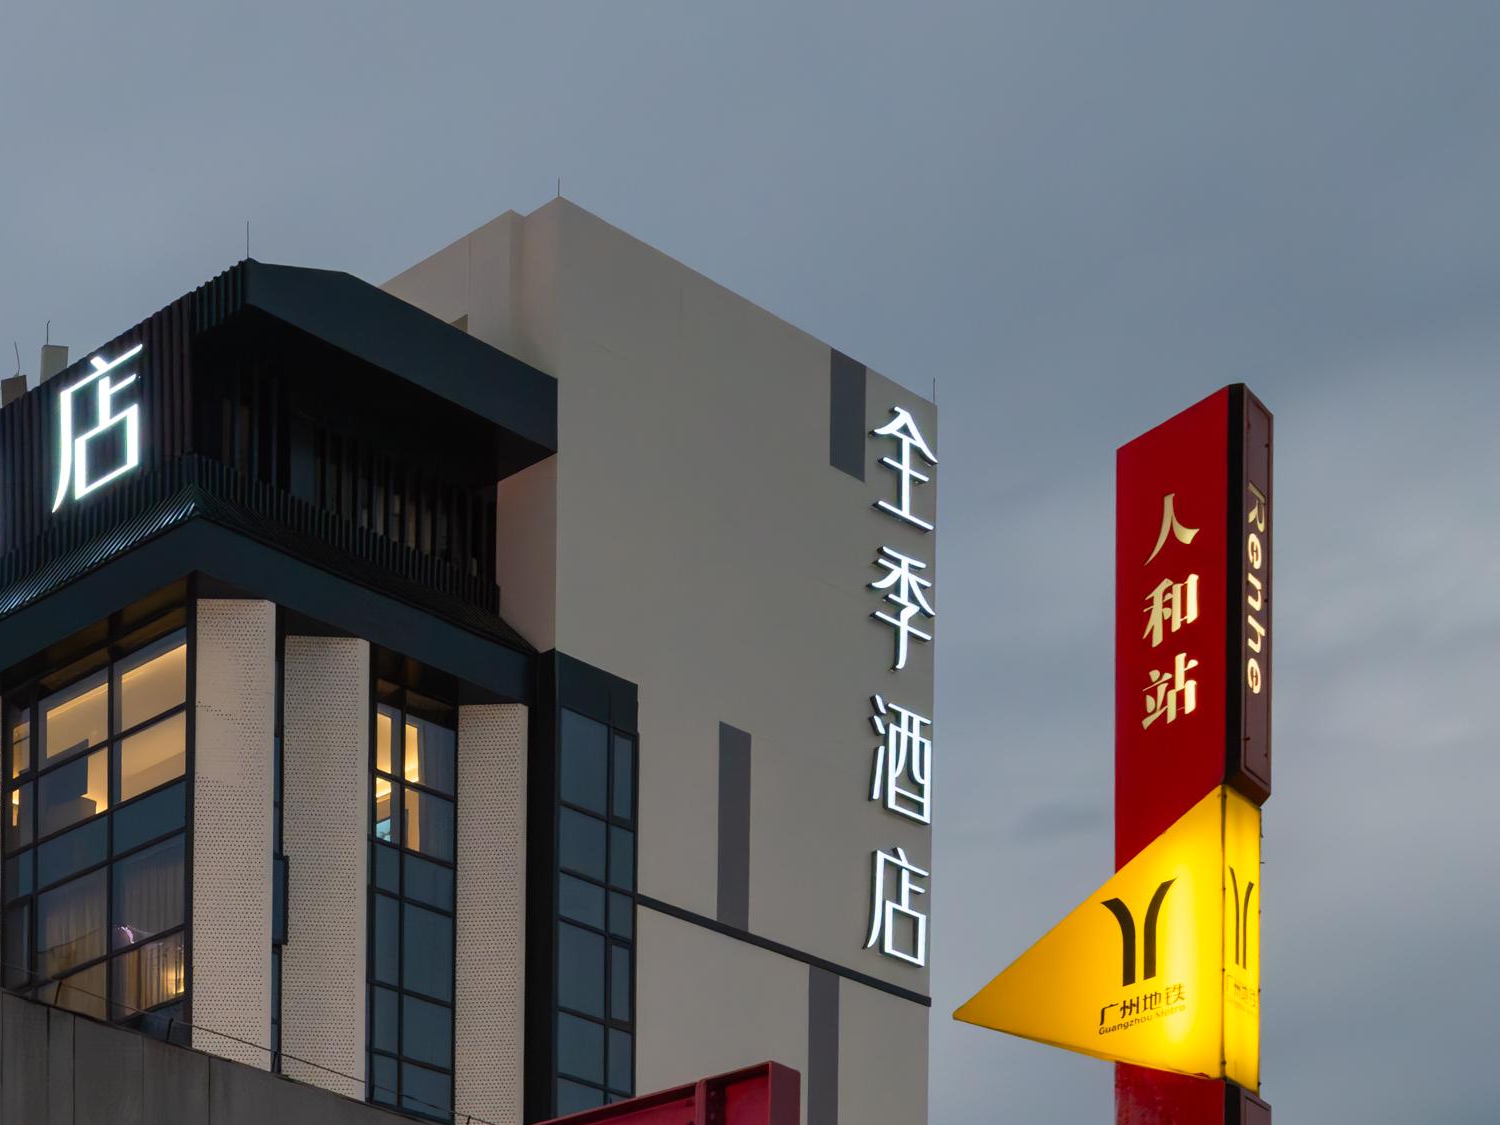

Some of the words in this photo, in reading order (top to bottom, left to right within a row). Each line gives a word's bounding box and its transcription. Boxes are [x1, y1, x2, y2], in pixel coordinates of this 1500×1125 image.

[863, 405, 938, 968] 全季酒店
[1141, 493, 1200, 730] 人和站
[1246, 482, 1267, 694] Renhe
[1099, 983, 1186, 1026] 广州地铁
[1099, 1015, 1153, 1035] Guangzhou
